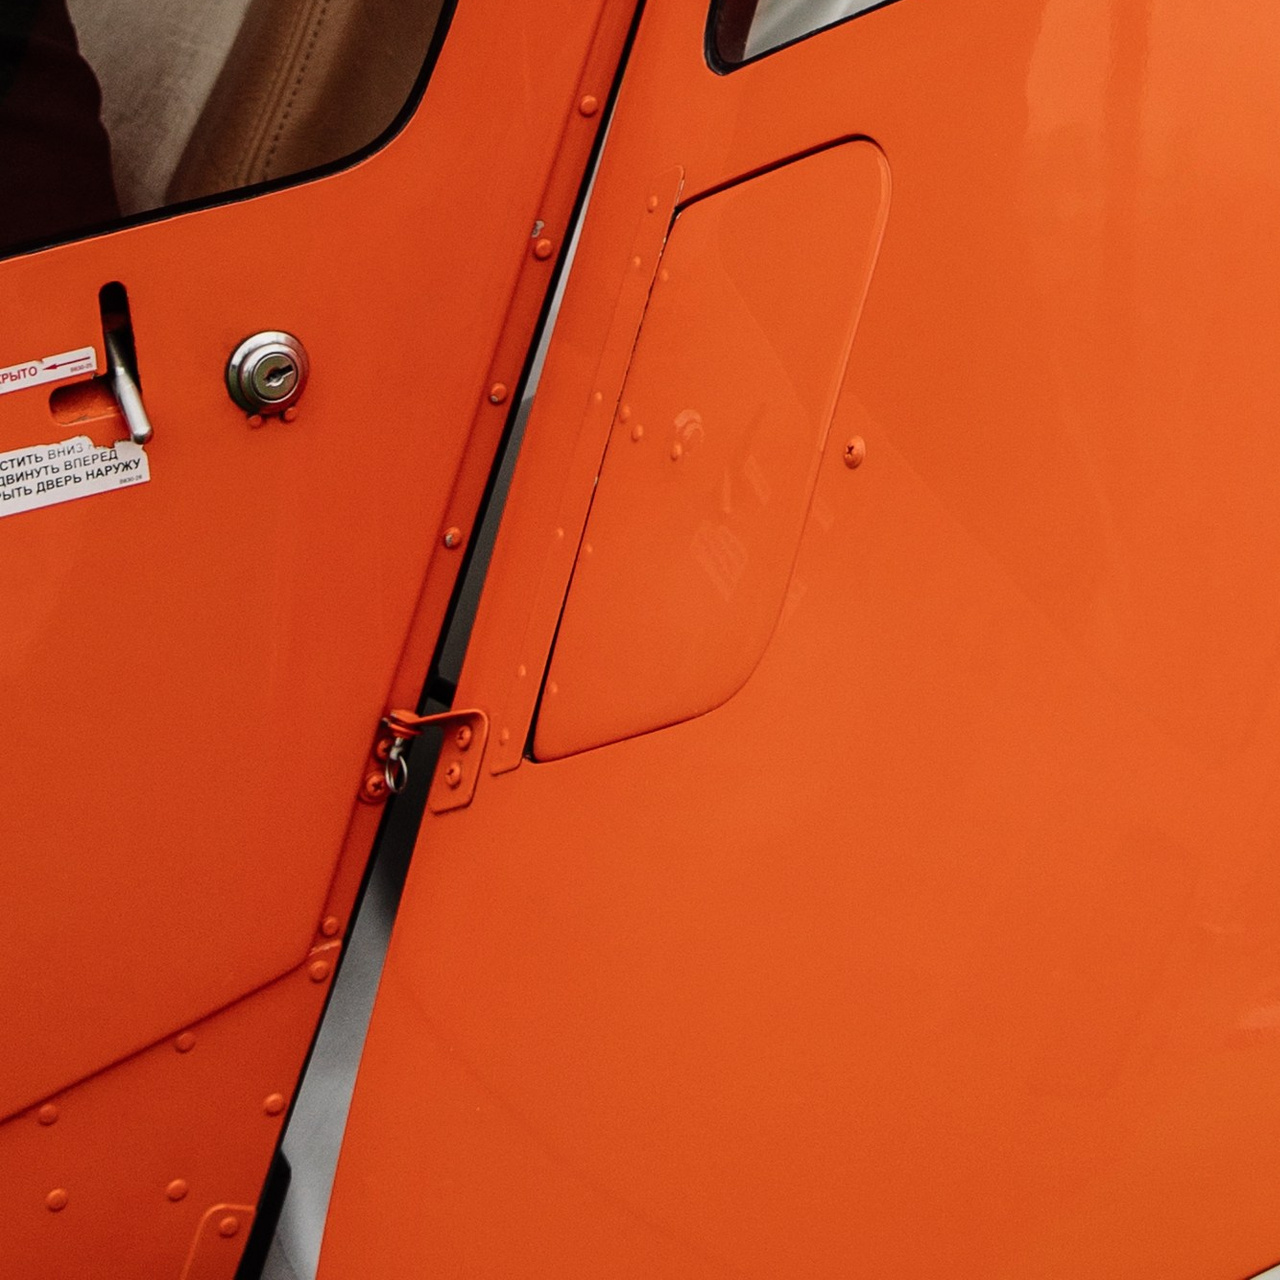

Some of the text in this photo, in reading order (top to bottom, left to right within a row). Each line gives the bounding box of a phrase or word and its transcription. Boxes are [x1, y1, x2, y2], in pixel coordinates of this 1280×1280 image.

[0, 366, 38, 384] РЫТО
[48, 442, 84, 460] ВНИЗ
[64, 449, 119, 471] ВПЕРЕД
[0, 485, 33, 501] ЫТЬ
[36, 474, 82, 495] ДВЕРЬ
[86, 457, 141, 481] НАРУЖУ
